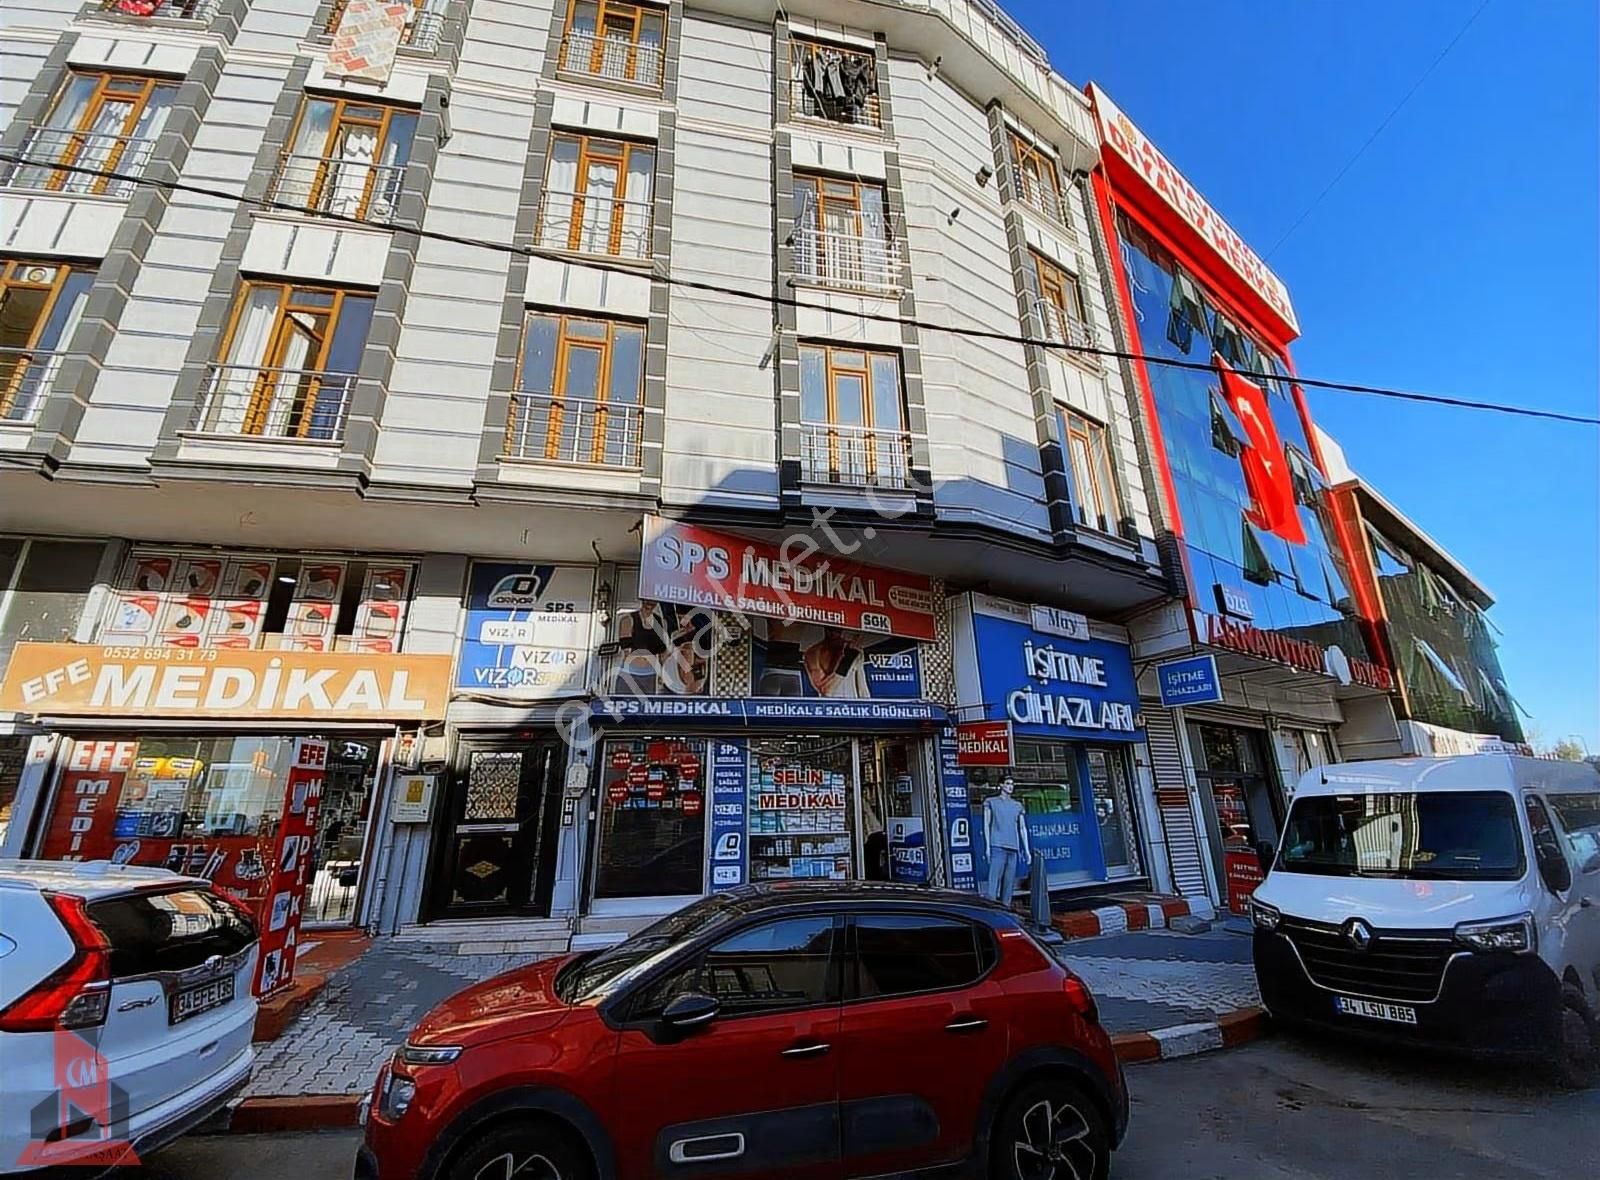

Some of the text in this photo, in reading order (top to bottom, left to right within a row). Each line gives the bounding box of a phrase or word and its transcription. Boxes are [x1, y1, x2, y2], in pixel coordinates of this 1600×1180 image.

[655, 536, 884, 608] SPS MEDİKAL
[545, 602, 575, 613] SPS
[654, 583, 722, 605] MEDİKAL
[738, 596, 785, 615] SAĞLIK
[788, 602, 845, 624] ÜRÜNLERİ
[864, 614, 889, 629] SGK
[1048, 608, 1077, 635] May
[103, 647, 218, 661] 0532 694 31 79
[1024, 640, 1107, 687] İŞİTME
[21, 657, 426, 711] EFE MEDİKAL
[603, 700, 639, 714] SPS
[644, 700, 731, 715] MEDİKAL
[755, 704, 812, 717] MEDİKAL
[826, 703, 869, 717] SAĞLIK
[872, 703, 931, 718] ÜRÜNLERİ
[1007, 685, 1135, 732] CİHAZLARI
[299, 744, 326, 766] EFE
[958, 737, 1008, 753] MEDİKAL
[69, 741, 136, 772] EFE
[773, 764, 824, 785] SELİN
[758, 793, 845, 809] MEDİKAL
[1341, 997, 1357, 1014] 34
